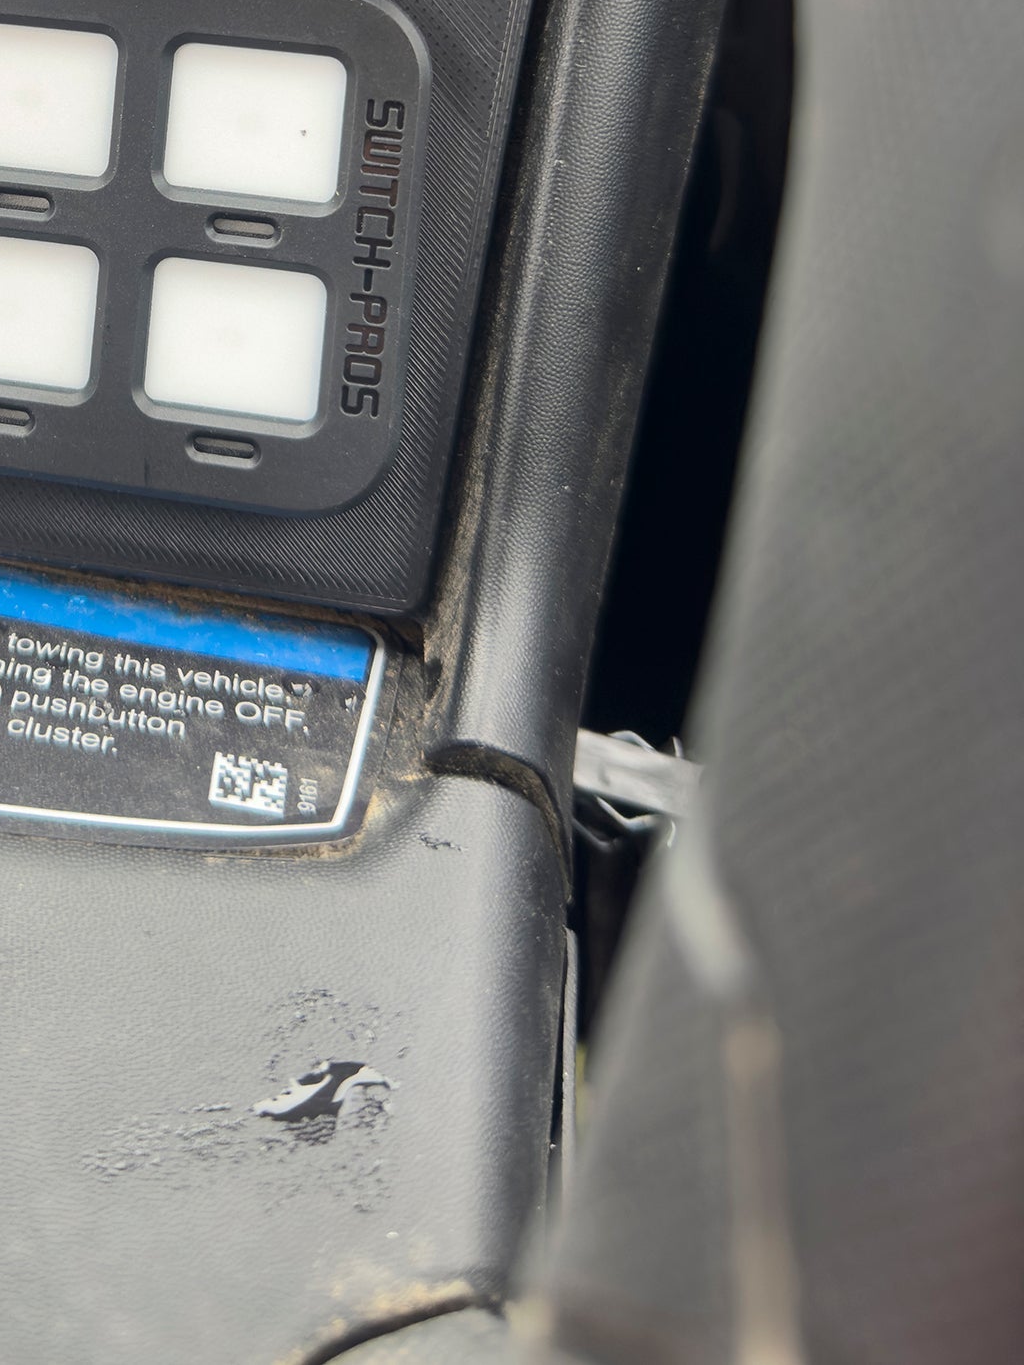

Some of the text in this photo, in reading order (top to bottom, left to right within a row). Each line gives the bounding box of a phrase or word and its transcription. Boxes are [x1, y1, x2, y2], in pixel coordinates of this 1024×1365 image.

[340, 98, 406, 419] SWITCH-PROS
[8, 632, 104, 675] towing
[114, 652, 167, 682] this
[10, 689, 187, 742] pushbutton
[62, 668, 110, 697] the
[119, 683, 226, 721] engine
[6, 716, 118, 758] cluster.
